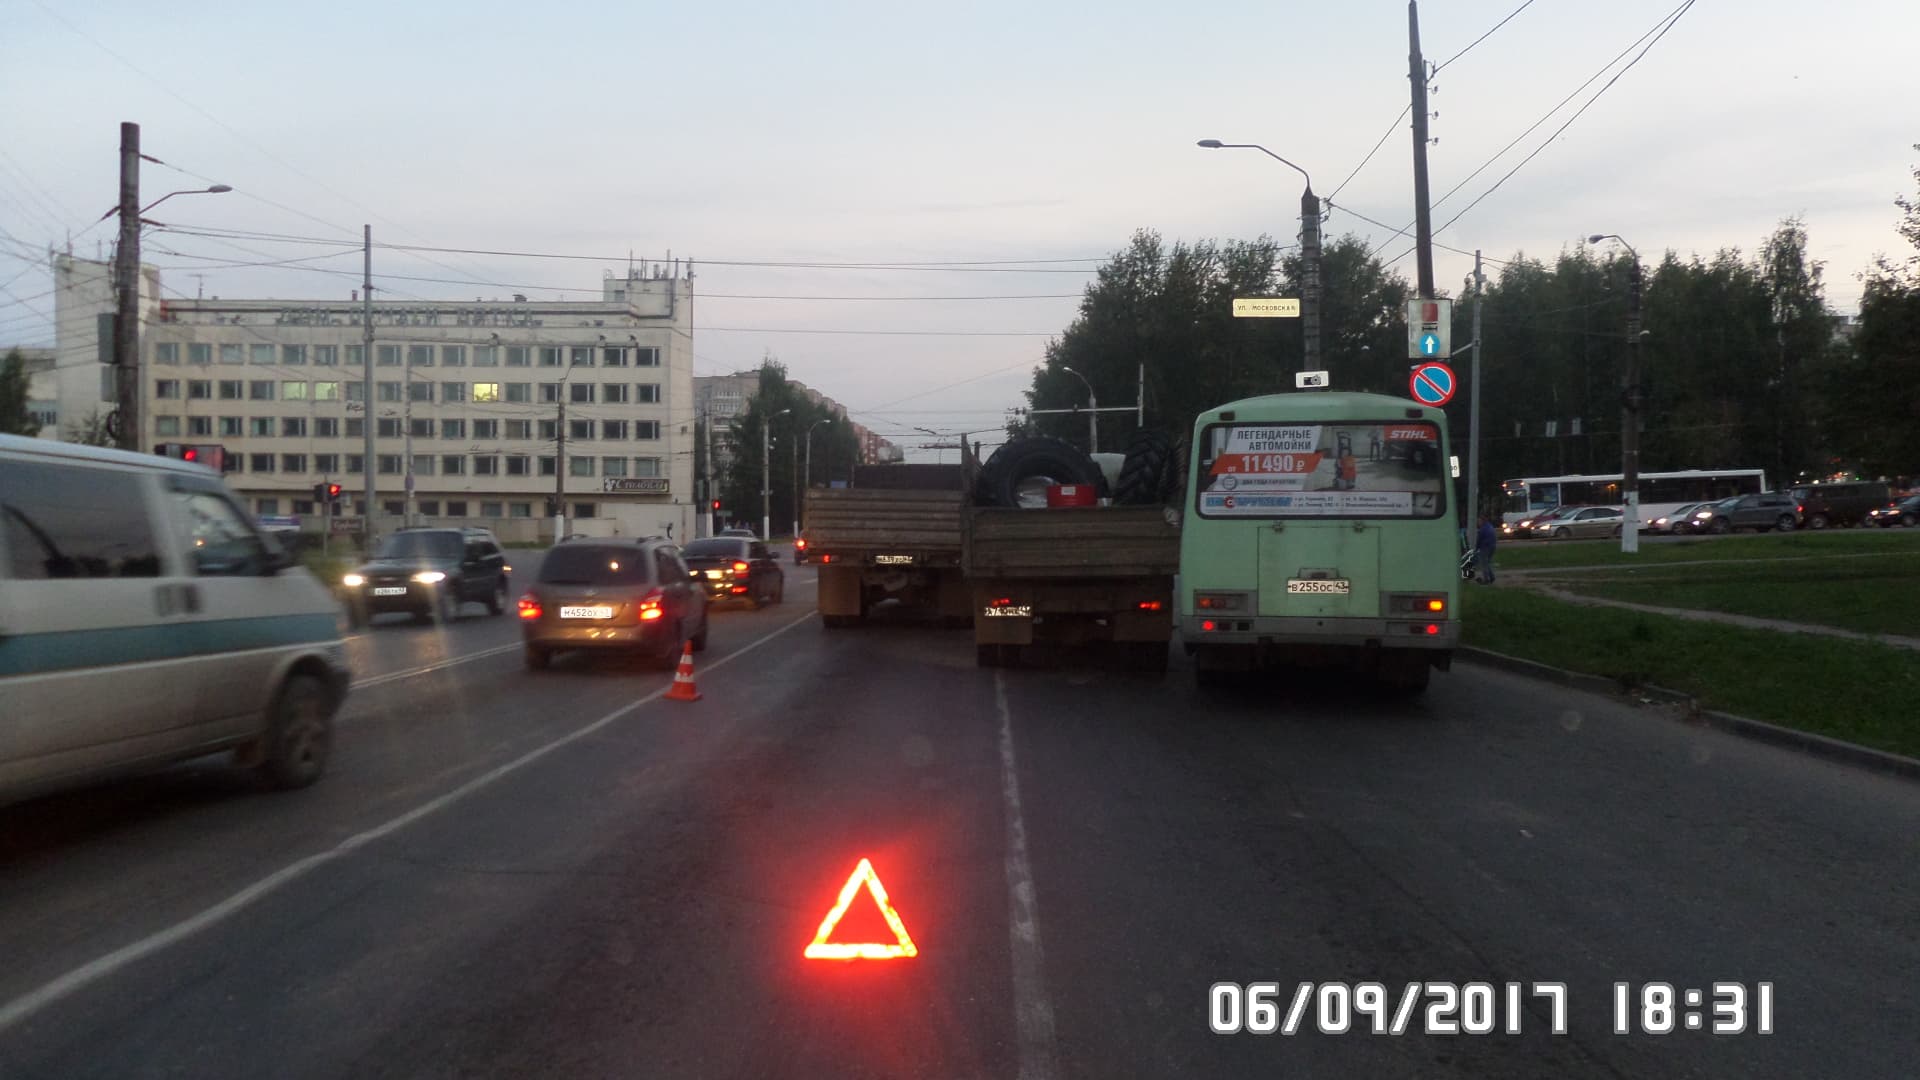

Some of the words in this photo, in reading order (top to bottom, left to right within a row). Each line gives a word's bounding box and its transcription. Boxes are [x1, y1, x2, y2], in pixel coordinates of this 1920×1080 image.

[1237, 430, 1312, 440] ЛЕГЕНДАРНЫЕ
[1390, 430, 1428, 439] STIHL
[1249, 439, 1312, 450] АВТОМОЙКИ
